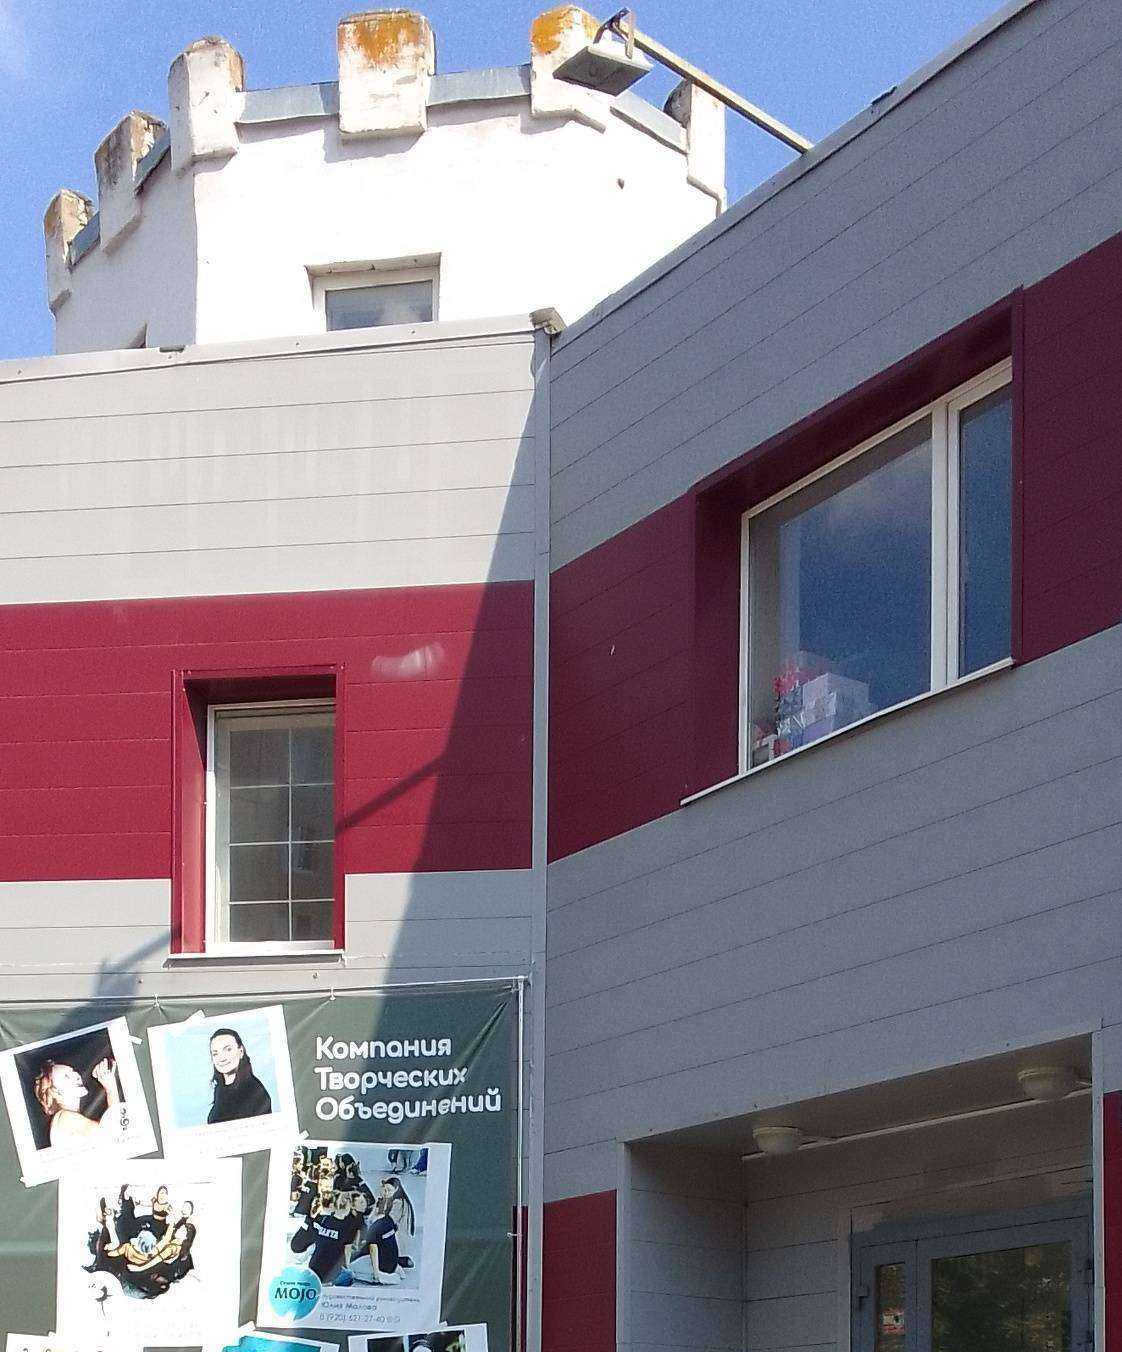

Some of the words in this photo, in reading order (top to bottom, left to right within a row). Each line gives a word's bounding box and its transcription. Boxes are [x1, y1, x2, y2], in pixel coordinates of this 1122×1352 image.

[315, 1036, 452, 1060] Компания
[314, 1067, 468, 1095] Творческих
[315, 1088, 501, 1124] Объединений
[274, 1287, 317, 1303] MOJO
